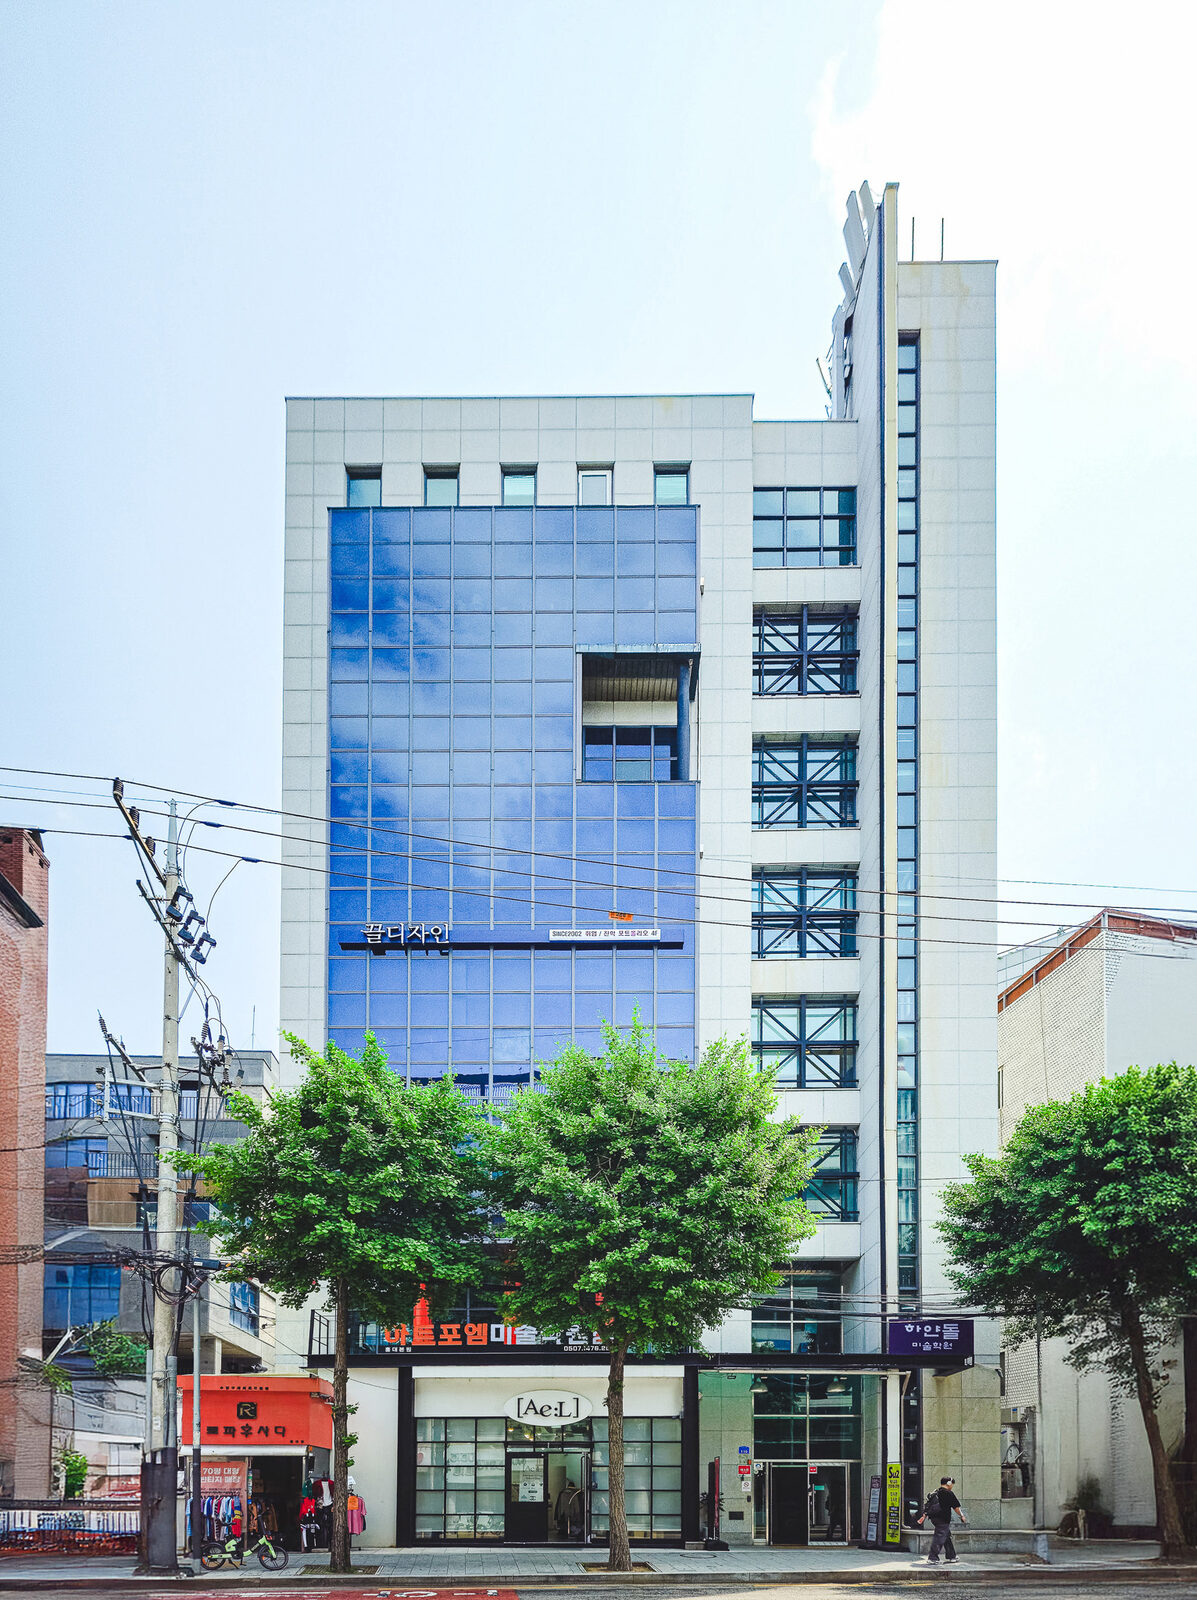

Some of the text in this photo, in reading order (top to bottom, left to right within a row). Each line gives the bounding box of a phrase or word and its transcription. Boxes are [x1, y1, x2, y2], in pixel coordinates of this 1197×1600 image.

[904, 1323, 960, 1340] 하얀돌
[911, 1341, 953, 1351] 미술학원
[517, 1397, 579, 1418] [Ae:L]
